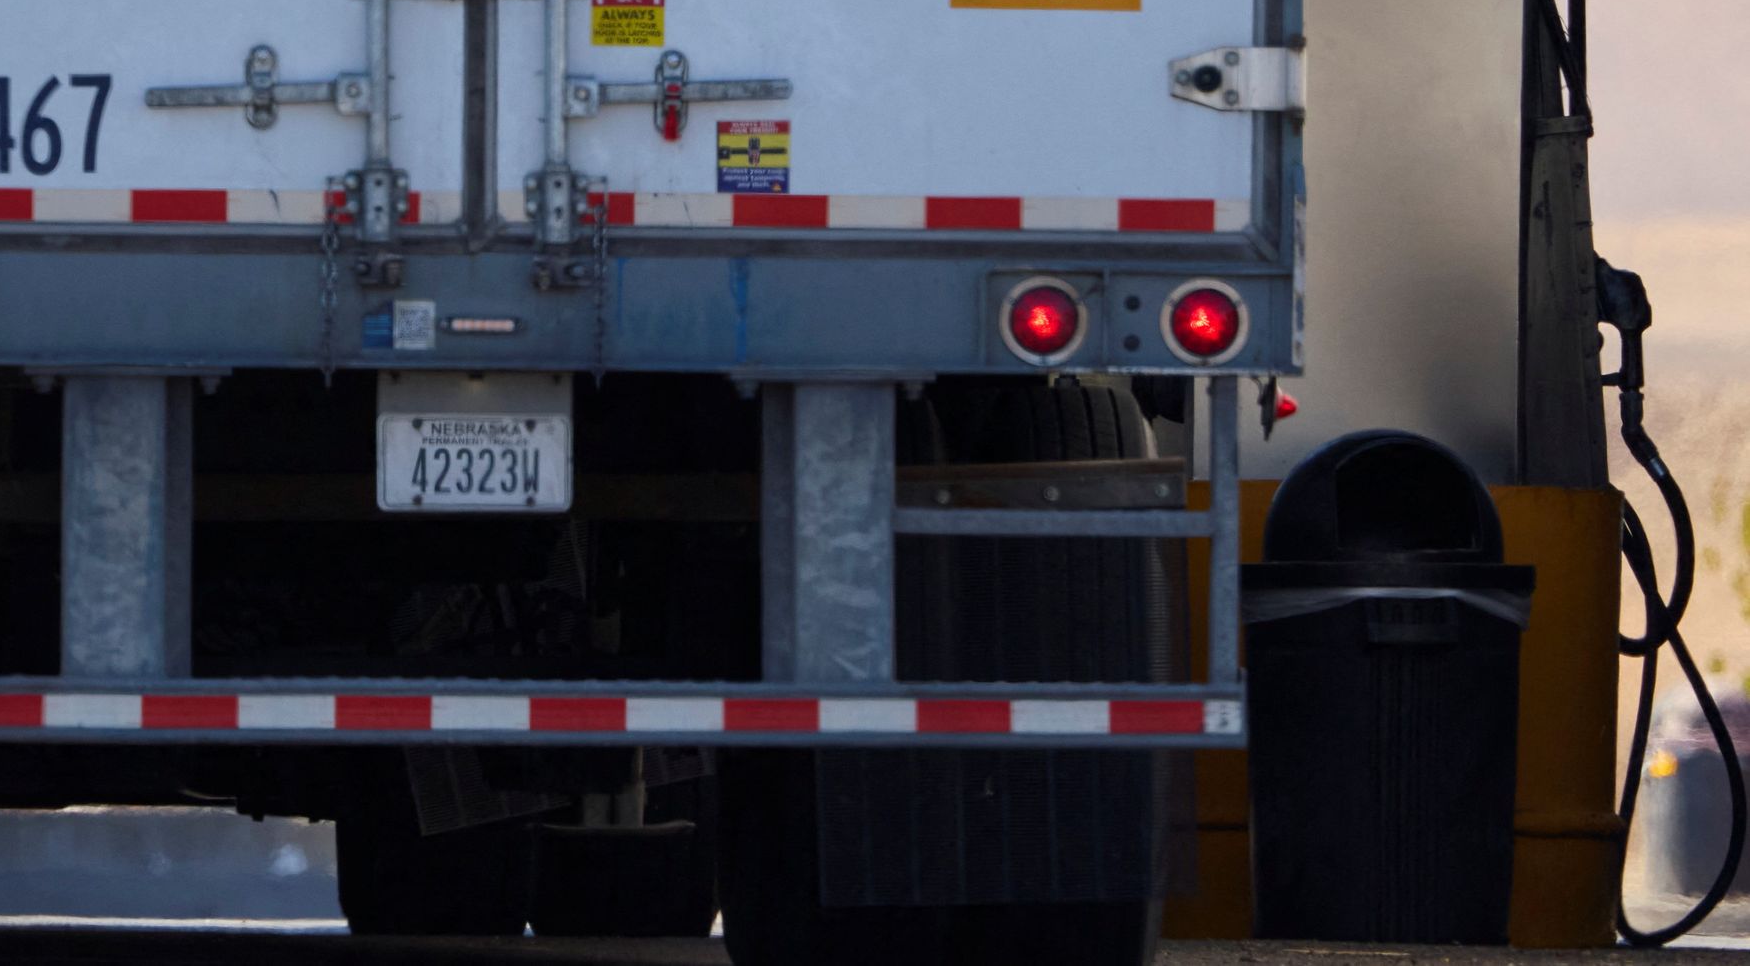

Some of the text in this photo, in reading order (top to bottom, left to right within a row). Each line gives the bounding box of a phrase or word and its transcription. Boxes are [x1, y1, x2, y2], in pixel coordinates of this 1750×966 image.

[601, 9, 656, 20] ALWAYS
[430, 422, 523, 436] NEBRASKA
[421, 437, 484, 445] PERMANENT
[411, 447, 539, 494] 42323W
